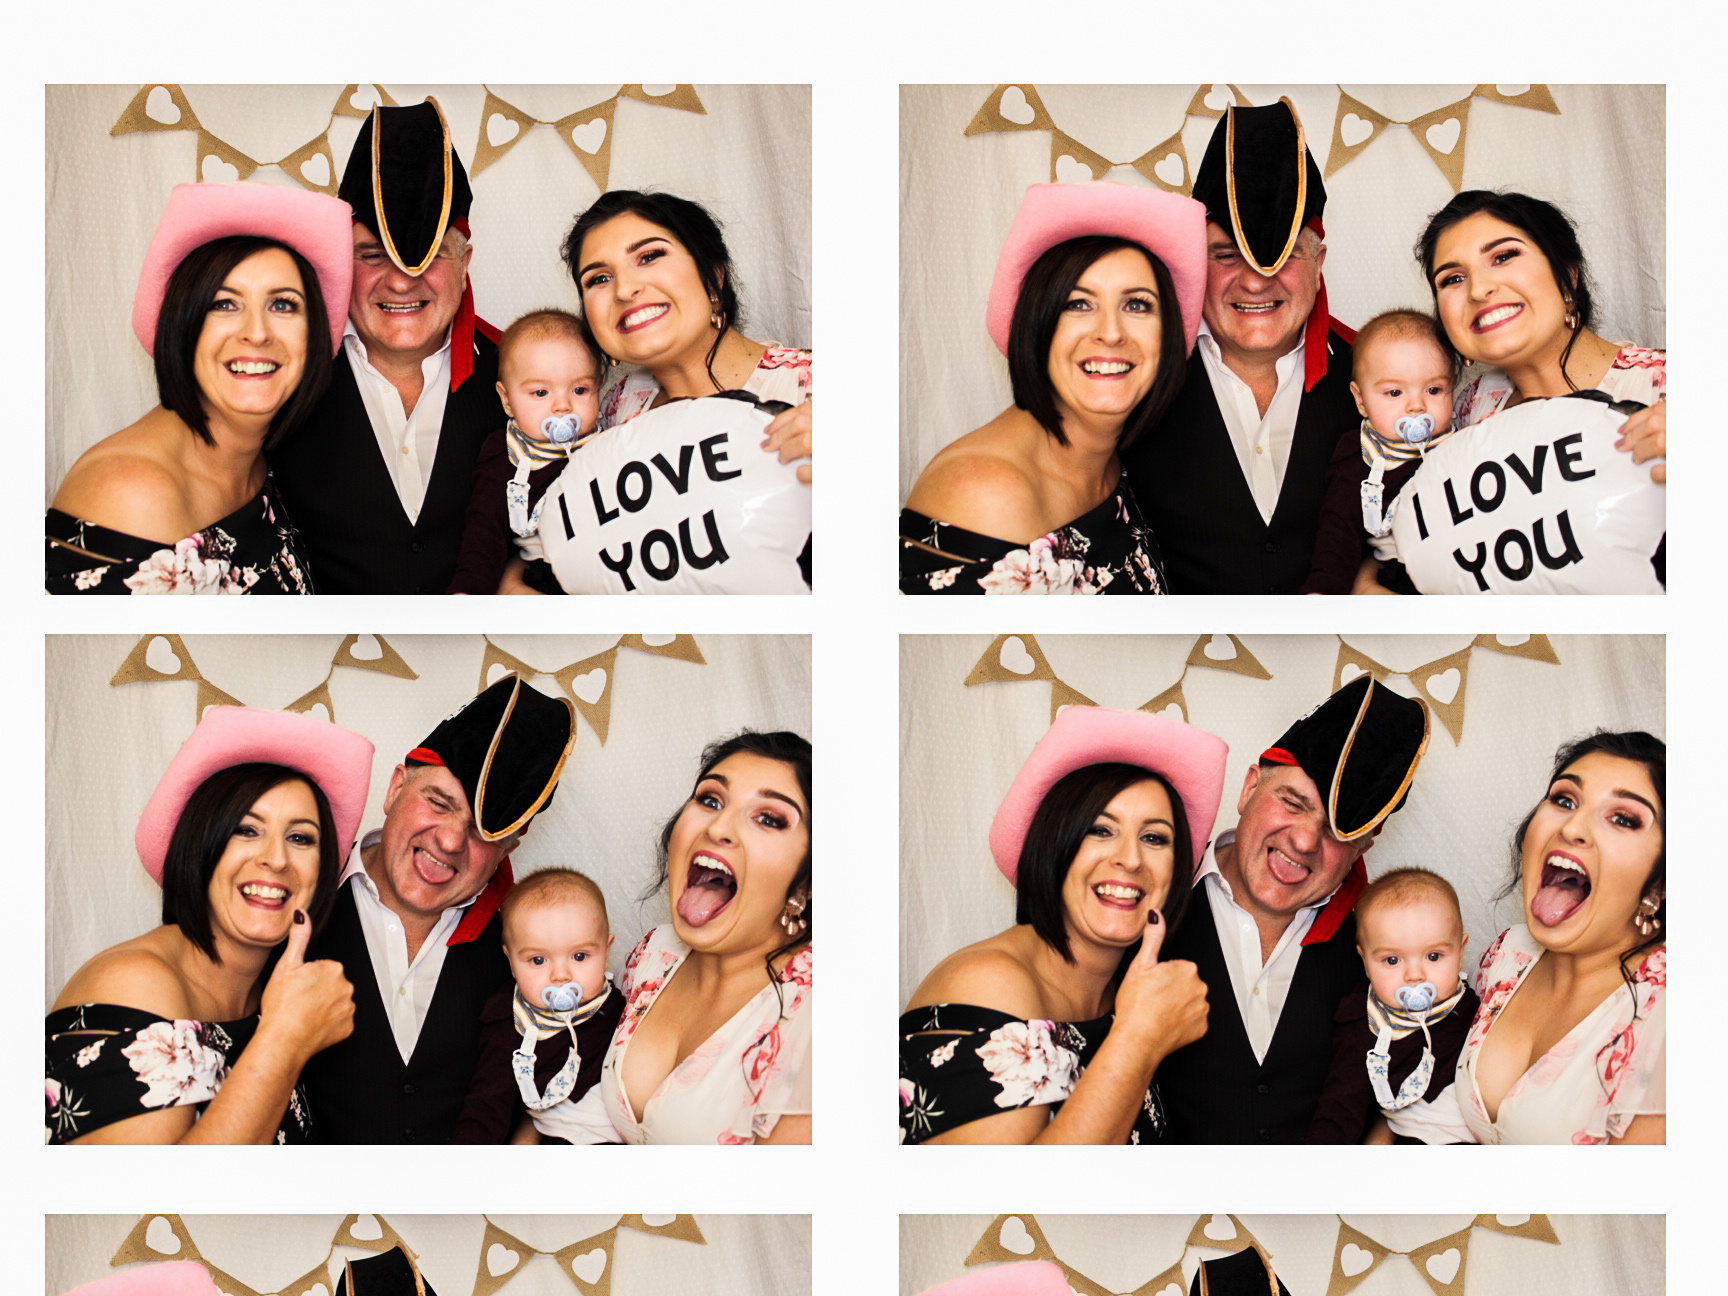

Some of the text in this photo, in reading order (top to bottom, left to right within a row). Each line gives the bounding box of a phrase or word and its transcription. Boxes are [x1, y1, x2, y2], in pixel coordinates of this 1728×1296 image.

[558, 432, 742, 541] I LOVE
[1412, 432, 1596, 541] I LOVE
[598, 509, 729, 592] YOU
[1452, 509, 1583, 592] YOU
